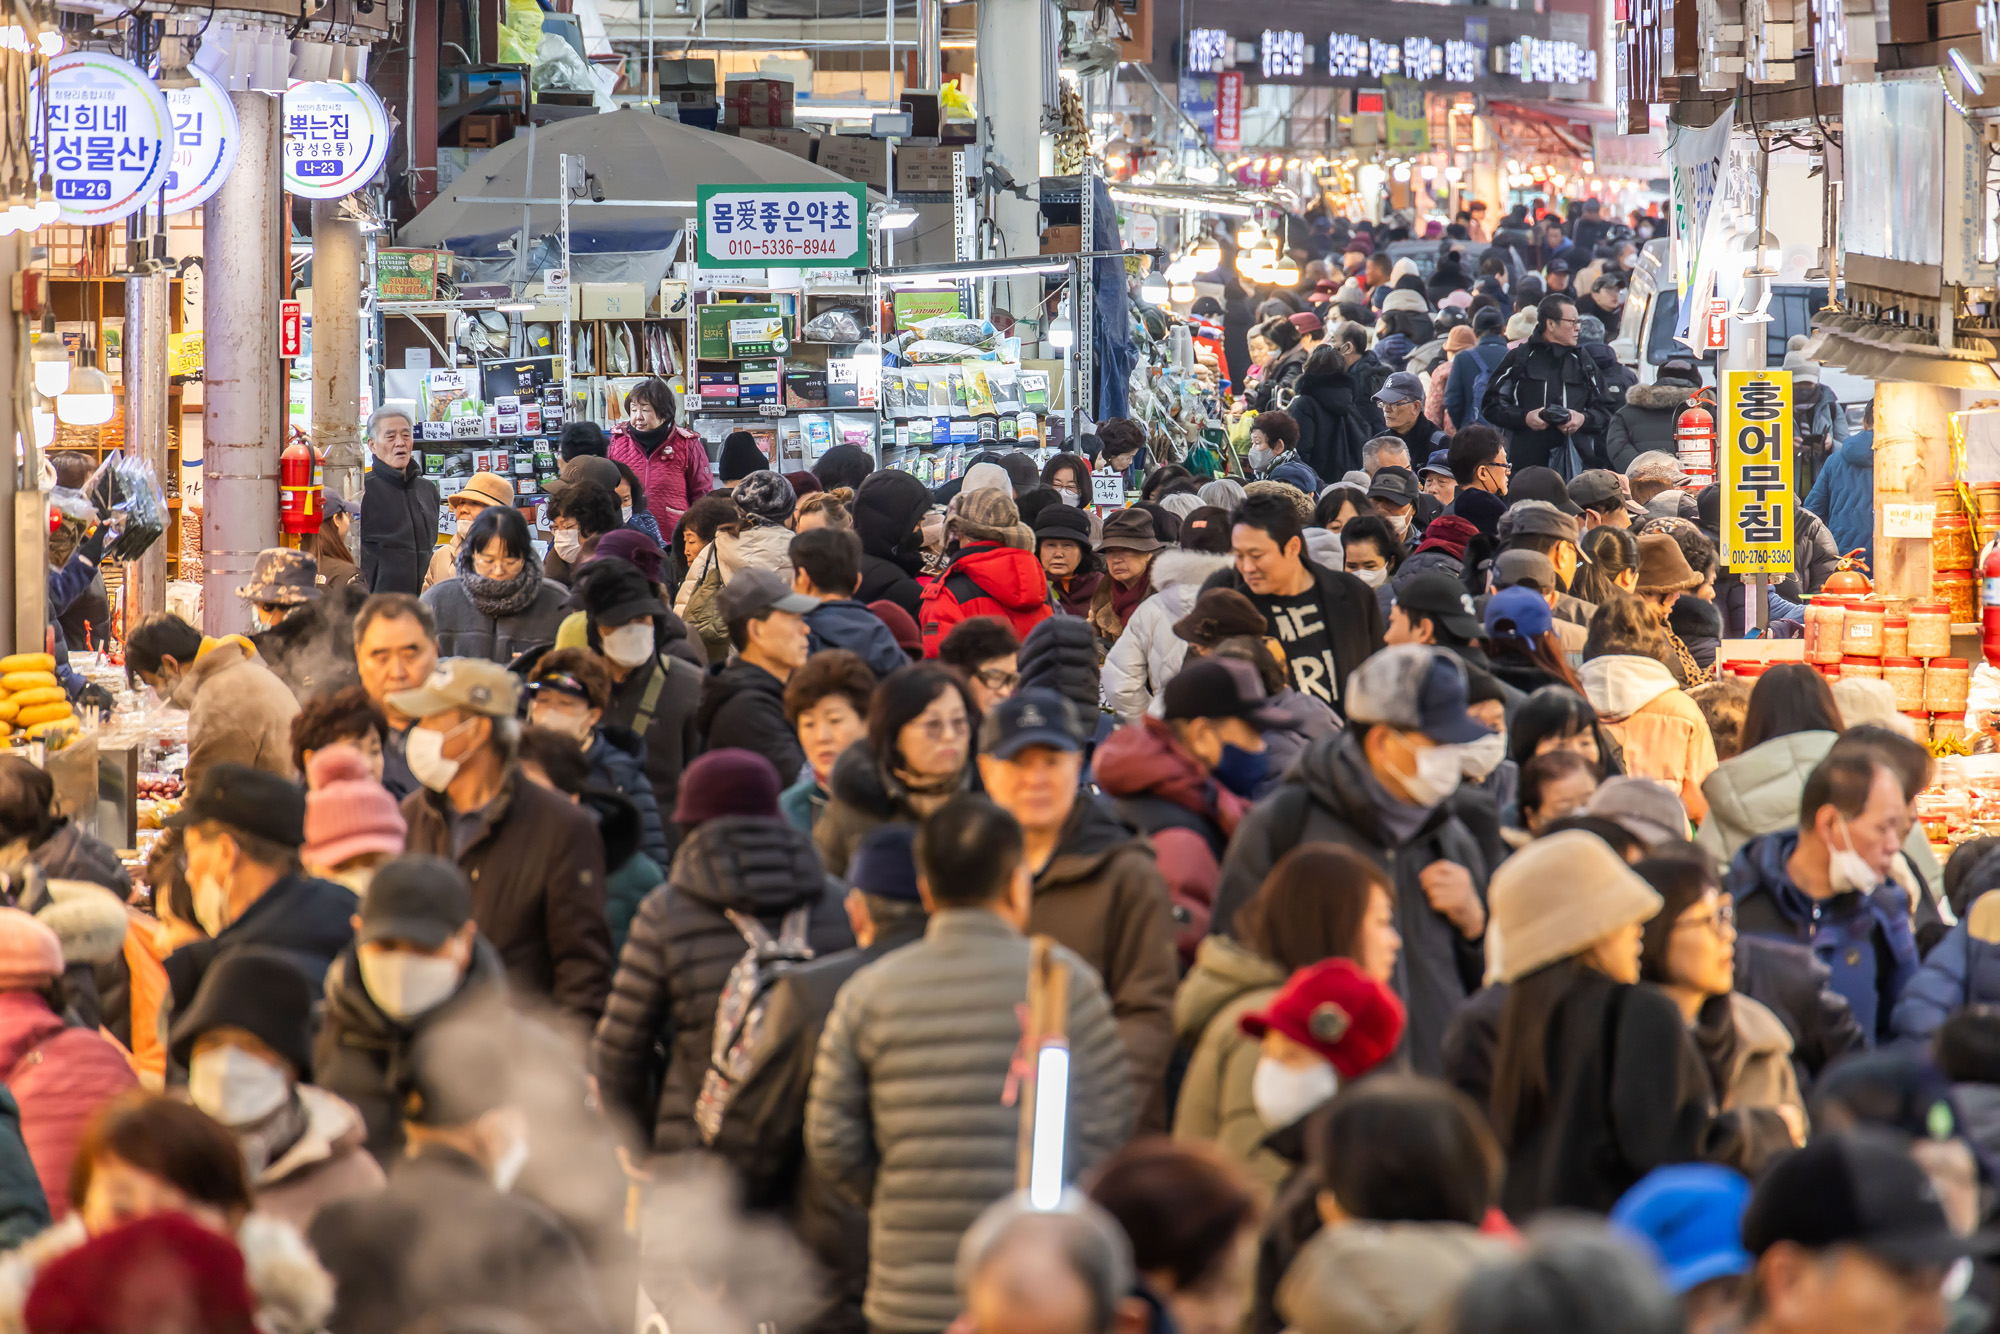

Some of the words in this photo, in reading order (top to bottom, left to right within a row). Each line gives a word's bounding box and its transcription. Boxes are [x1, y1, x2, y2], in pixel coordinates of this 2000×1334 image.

[48, 104, 127, 132] 진희네
[174, 112, 203, 146] 김
[304, 162, 335, 175] 나-23
[61, 182, 107, 198] 나-26
[728, 238, 836, 255] 010-5336-8944
[382, 284, 428, 294] PODESTA
[389, 277, 421, 285] FARMS
[178, 354, 203, 372] 참여
[1736, 381, 1786, 543] 홍어무침
[1732, 550, 1792, 565] 010-2760-3360
